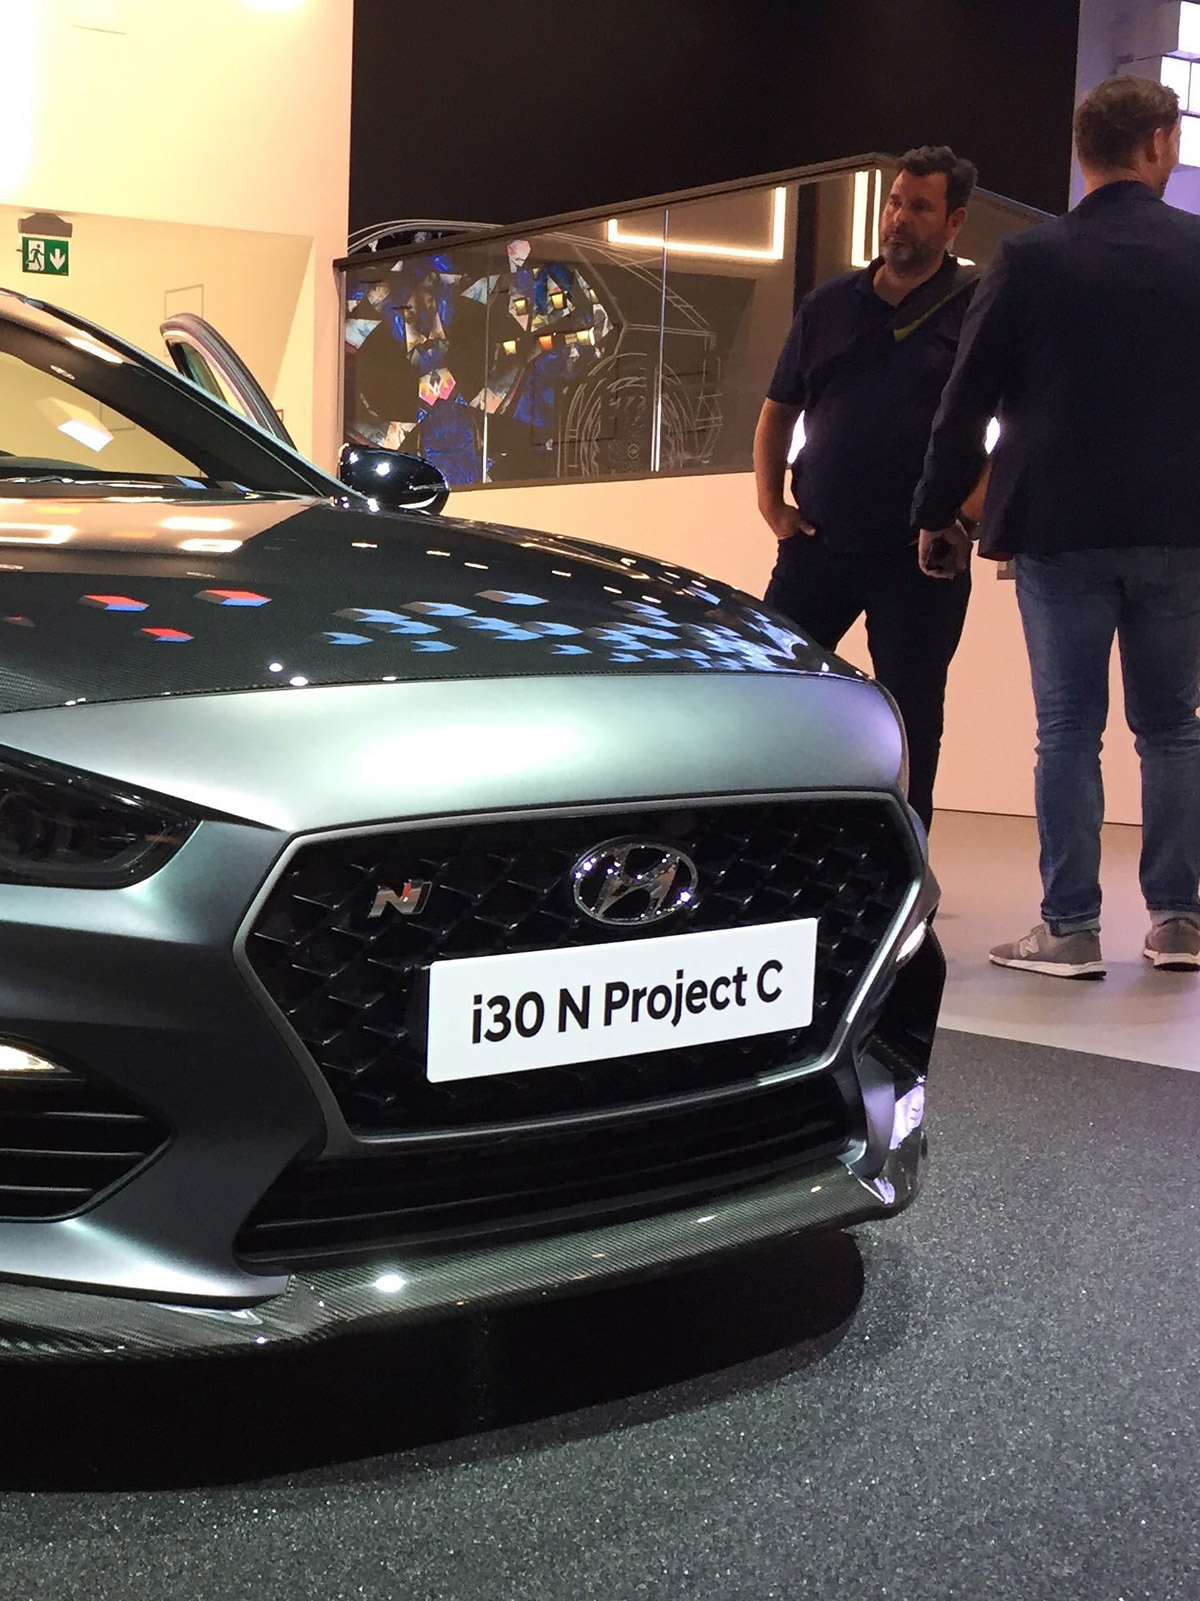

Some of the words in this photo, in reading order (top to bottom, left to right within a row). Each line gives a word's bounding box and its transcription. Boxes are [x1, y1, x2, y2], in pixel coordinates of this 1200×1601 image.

[472, 991, 545, 1044] i30
[557, 985, 590, 1033] N
[603, 966, 748, 1028] Project
[756, 959, 783, 1003] C
